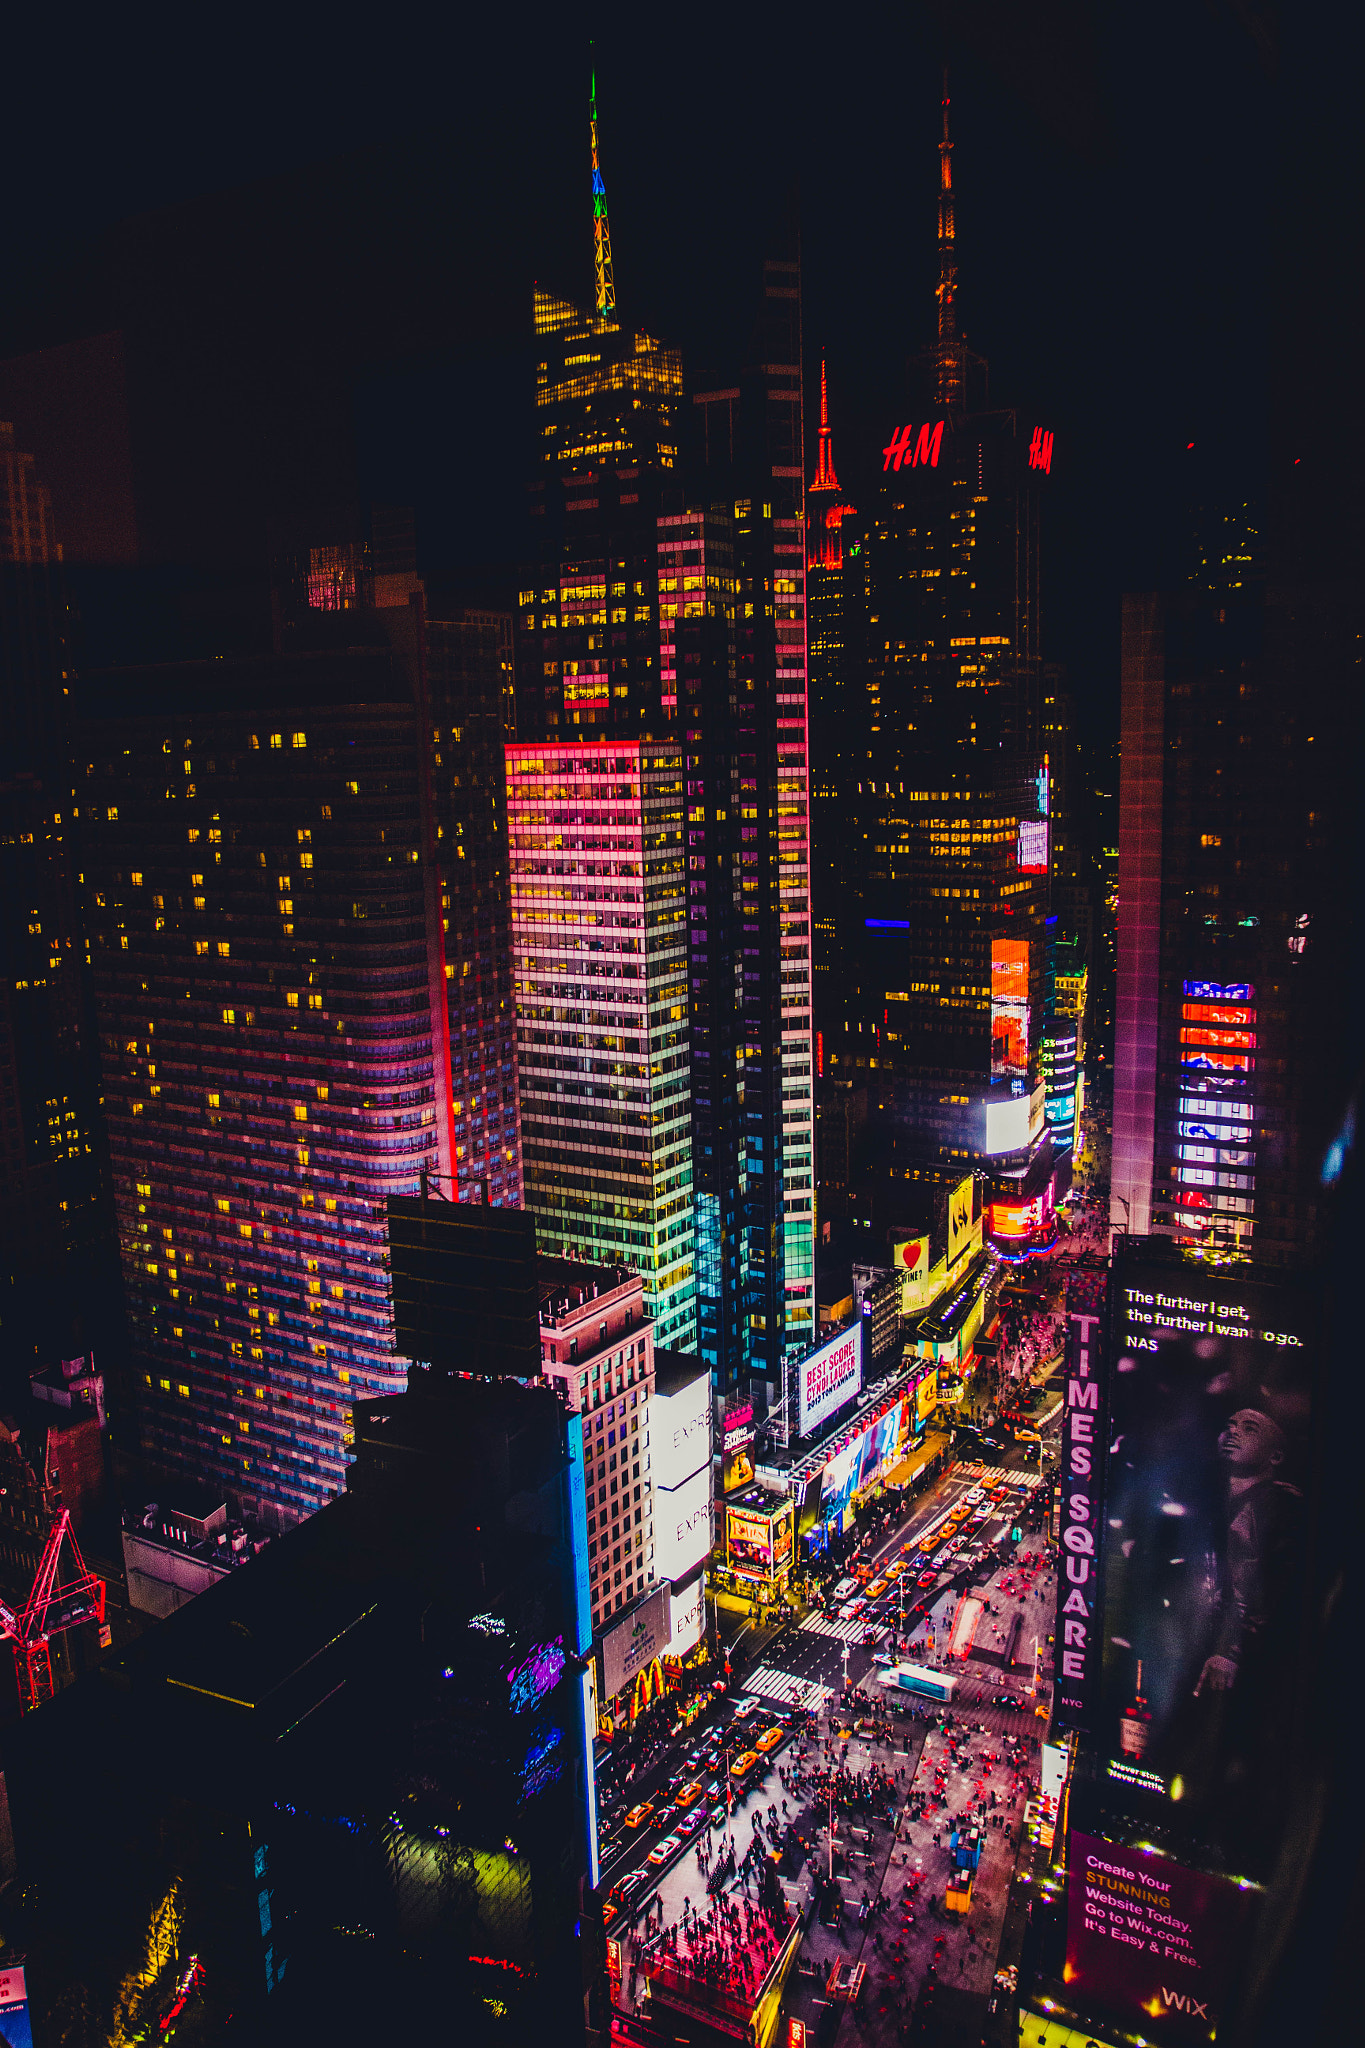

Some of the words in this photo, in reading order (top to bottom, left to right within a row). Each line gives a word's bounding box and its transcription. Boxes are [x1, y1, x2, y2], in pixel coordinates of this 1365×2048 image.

[882, 420, 945, 472] H&M
[1029, 425, 1054, 475] H&M
[1124, 1288, 1154, 1305] The
[1155, 1293, 1209, 1314] further
[1209, 1301, 1215, 1314] I
[1217, 1304, 1250, 1321] get,
[1126, 1309, 1153, 1324] the
[1154, 1312, 1207, 1333] further
[1207, 1320, 1214, 1334] I
[806, 1359, 827, 1388] BEST
[829, 1338, 856, 1371] SCORE!
[1125, 1335, 1159, 1353] NAS
[806, 1373, 829, 1402] CYNDI
[830, 1355, 856, 1385] LAUPER
[1067, 1313, 1100, 1475] TIMES
[1061, 1493, 1095, 1680] SQUARE
[1061, 1696, 1083, 1709] NYC
[1106, 1767, 1137, 1784] Never
[1110, 1759, 1140, 1775] Never
[1086, 1855, 1136, 1880] Create
[1138, 1871, 1172, 1892] Your
[1086, 1870, 1171, 1909] STUNNING
[1085, 1885, 1143, 1915] Website
[1146, 1907, 1192, 1933] Today.
[1085, 1902, 1106, 1918] Go
[1109, 1911, 1124, 1925] to
[1126, 1916, 1194, 1950] Wix.com.
[1085, 1917, 1106, 1935] It's
[1111, 1926, 1146, 1950] Easy
[1149, 1941, 1160, 1954] &
[1164, 1945, 1202, 1969] Free.
